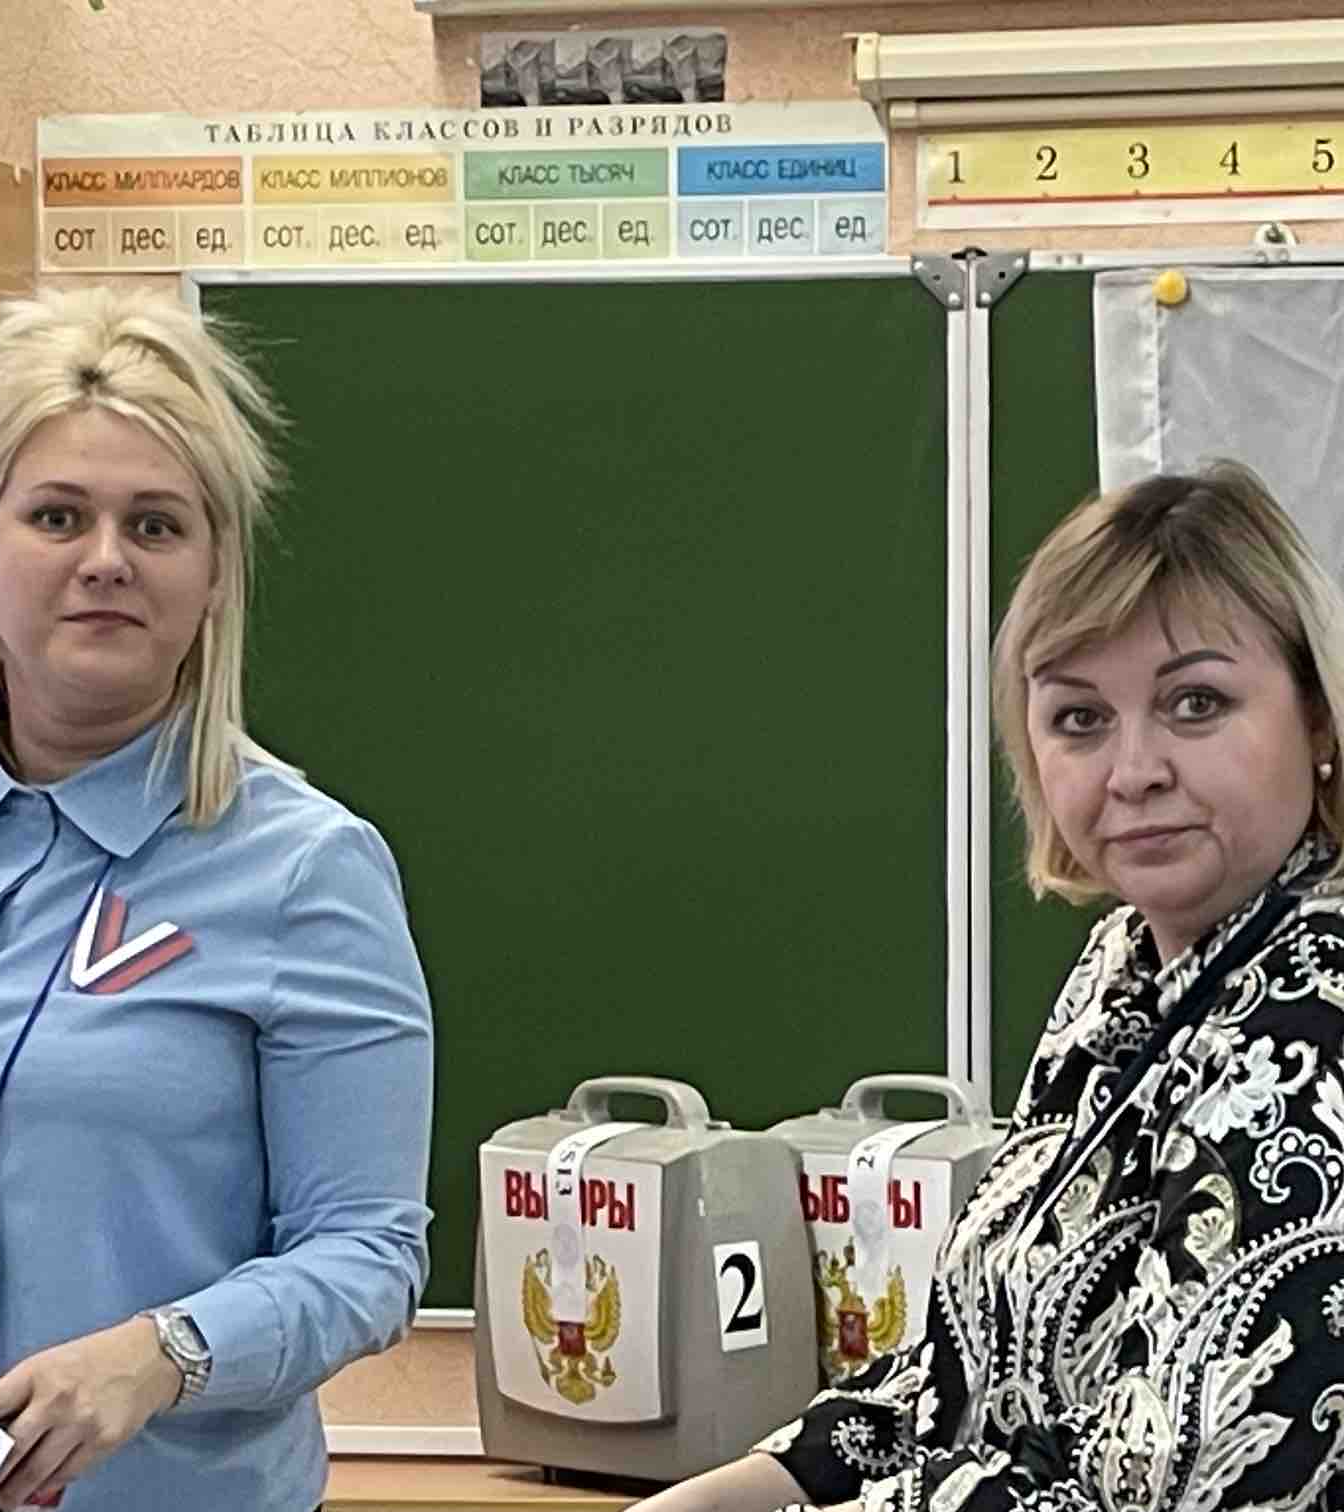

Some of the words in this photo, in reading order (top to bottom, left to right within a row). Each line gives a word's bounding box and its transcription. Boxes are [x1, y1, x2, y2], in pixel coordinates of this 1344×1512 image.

[204, 122, 356, 145] ТАБЛИЦА
[373, 119, 520, 142] КЛАССОВ
[535, 118, 552, 137] И
[568, 114, 733, 137] РАЗРЯДОВ
[497, 164, 560, 186] КЛАСС
[567, 163, 636, 185] ТЫСЯЧ
[706, 159, 770, 181] КЛАСС
[777, 157, 857, 182] ЕДИНИЦ
[948, 152, 965, 185] 1
[1036, 146, 1057, 181] 2
[1127, 144, 1150, 178] 3
[1218, 142, 1240, 176] 4
[1312, 139, 1335, 173] 5
[47, 171, 106, 191] КЛАСС
[114, 169, 241, 193] МИЛЛИАРДОВ
[260, 168, 321, 189] КЛАСС
[329, 167, 449, 188] МИЛЛИОНОВ
[504, 1168, 635, 1231] ВЫРЫ
[720, 1252, 762, 1334] 2
